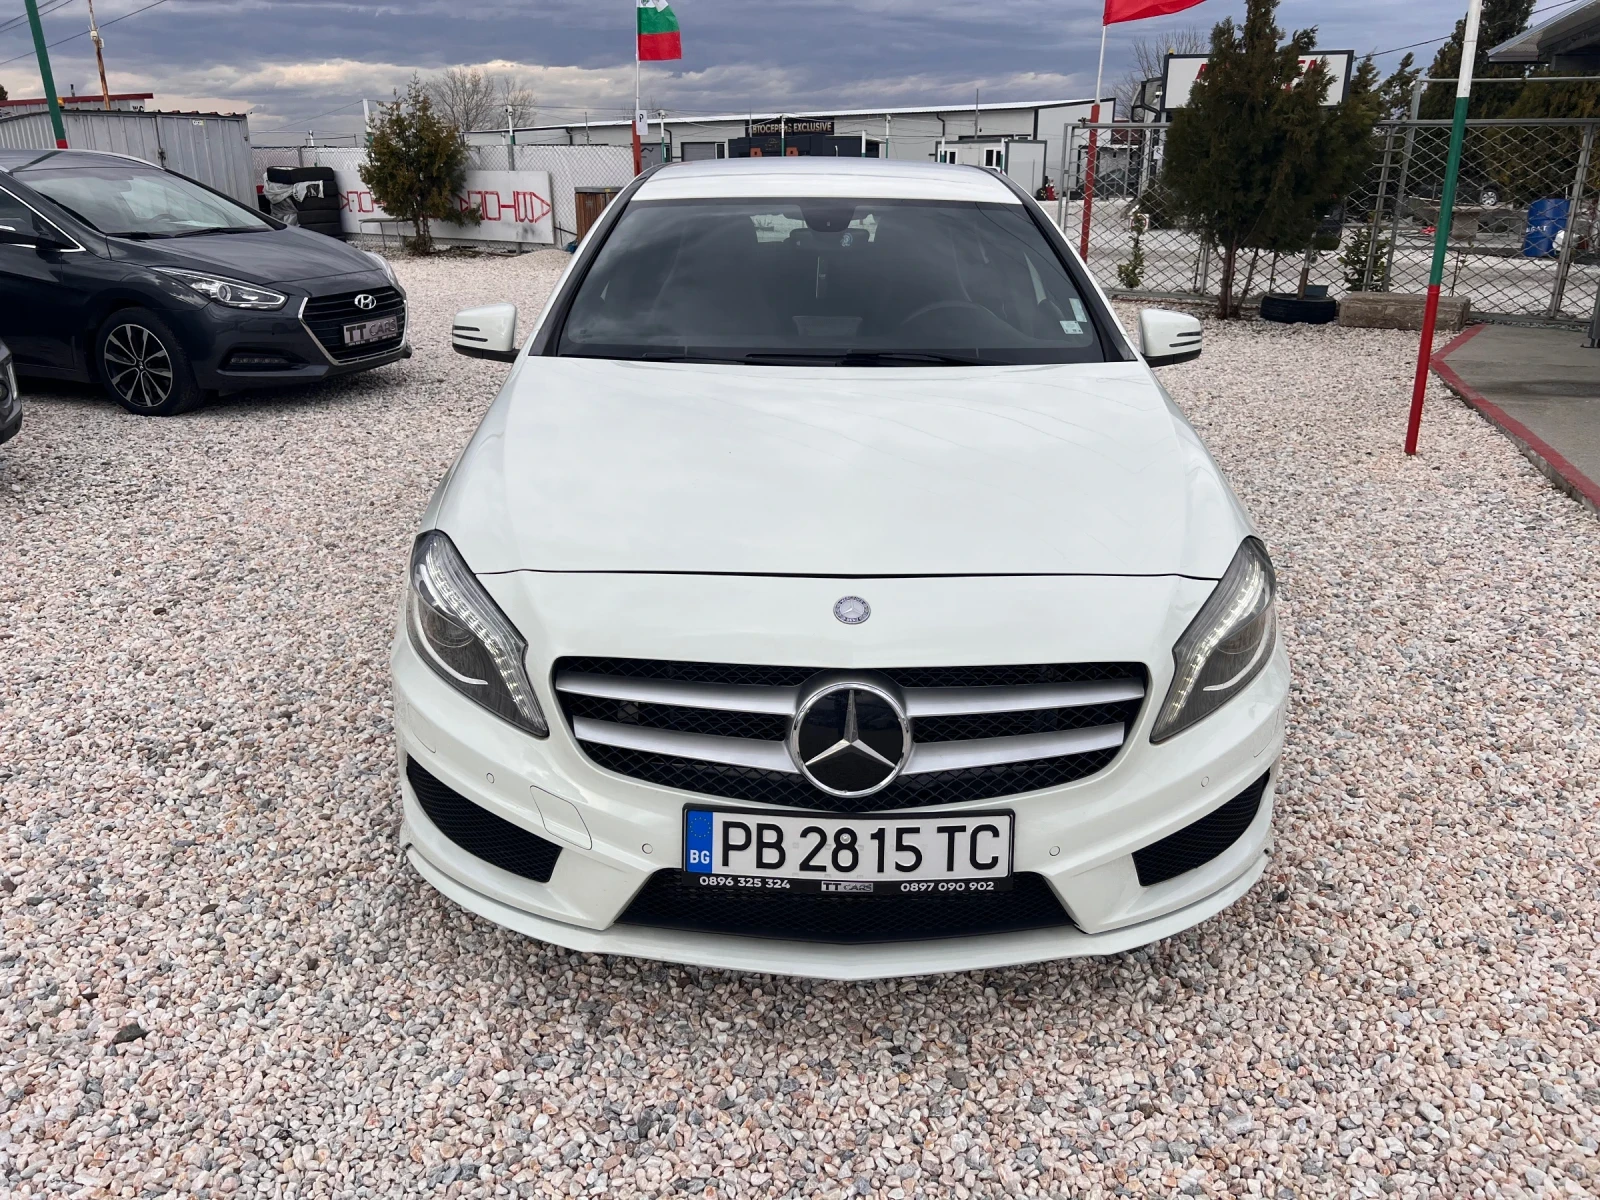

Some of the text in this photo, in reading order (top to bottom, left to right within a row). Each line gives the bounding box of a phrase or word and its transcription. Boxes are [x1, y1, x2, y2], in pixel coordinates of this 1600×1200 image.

[793, 122, 832, 132] EXCLUSIVE
[346, 324, 366, 342] TT
[369, 318, 396, 336] CARS
[721, 820, 1000, 873] PB 2815 TC
[689, 849, 710, 864] BG
[699, 876, 790, 889] 0896 325 324
[823, 882, 872, 891] TT CARS
[900, 881, 994, 892] 0897 090 902
